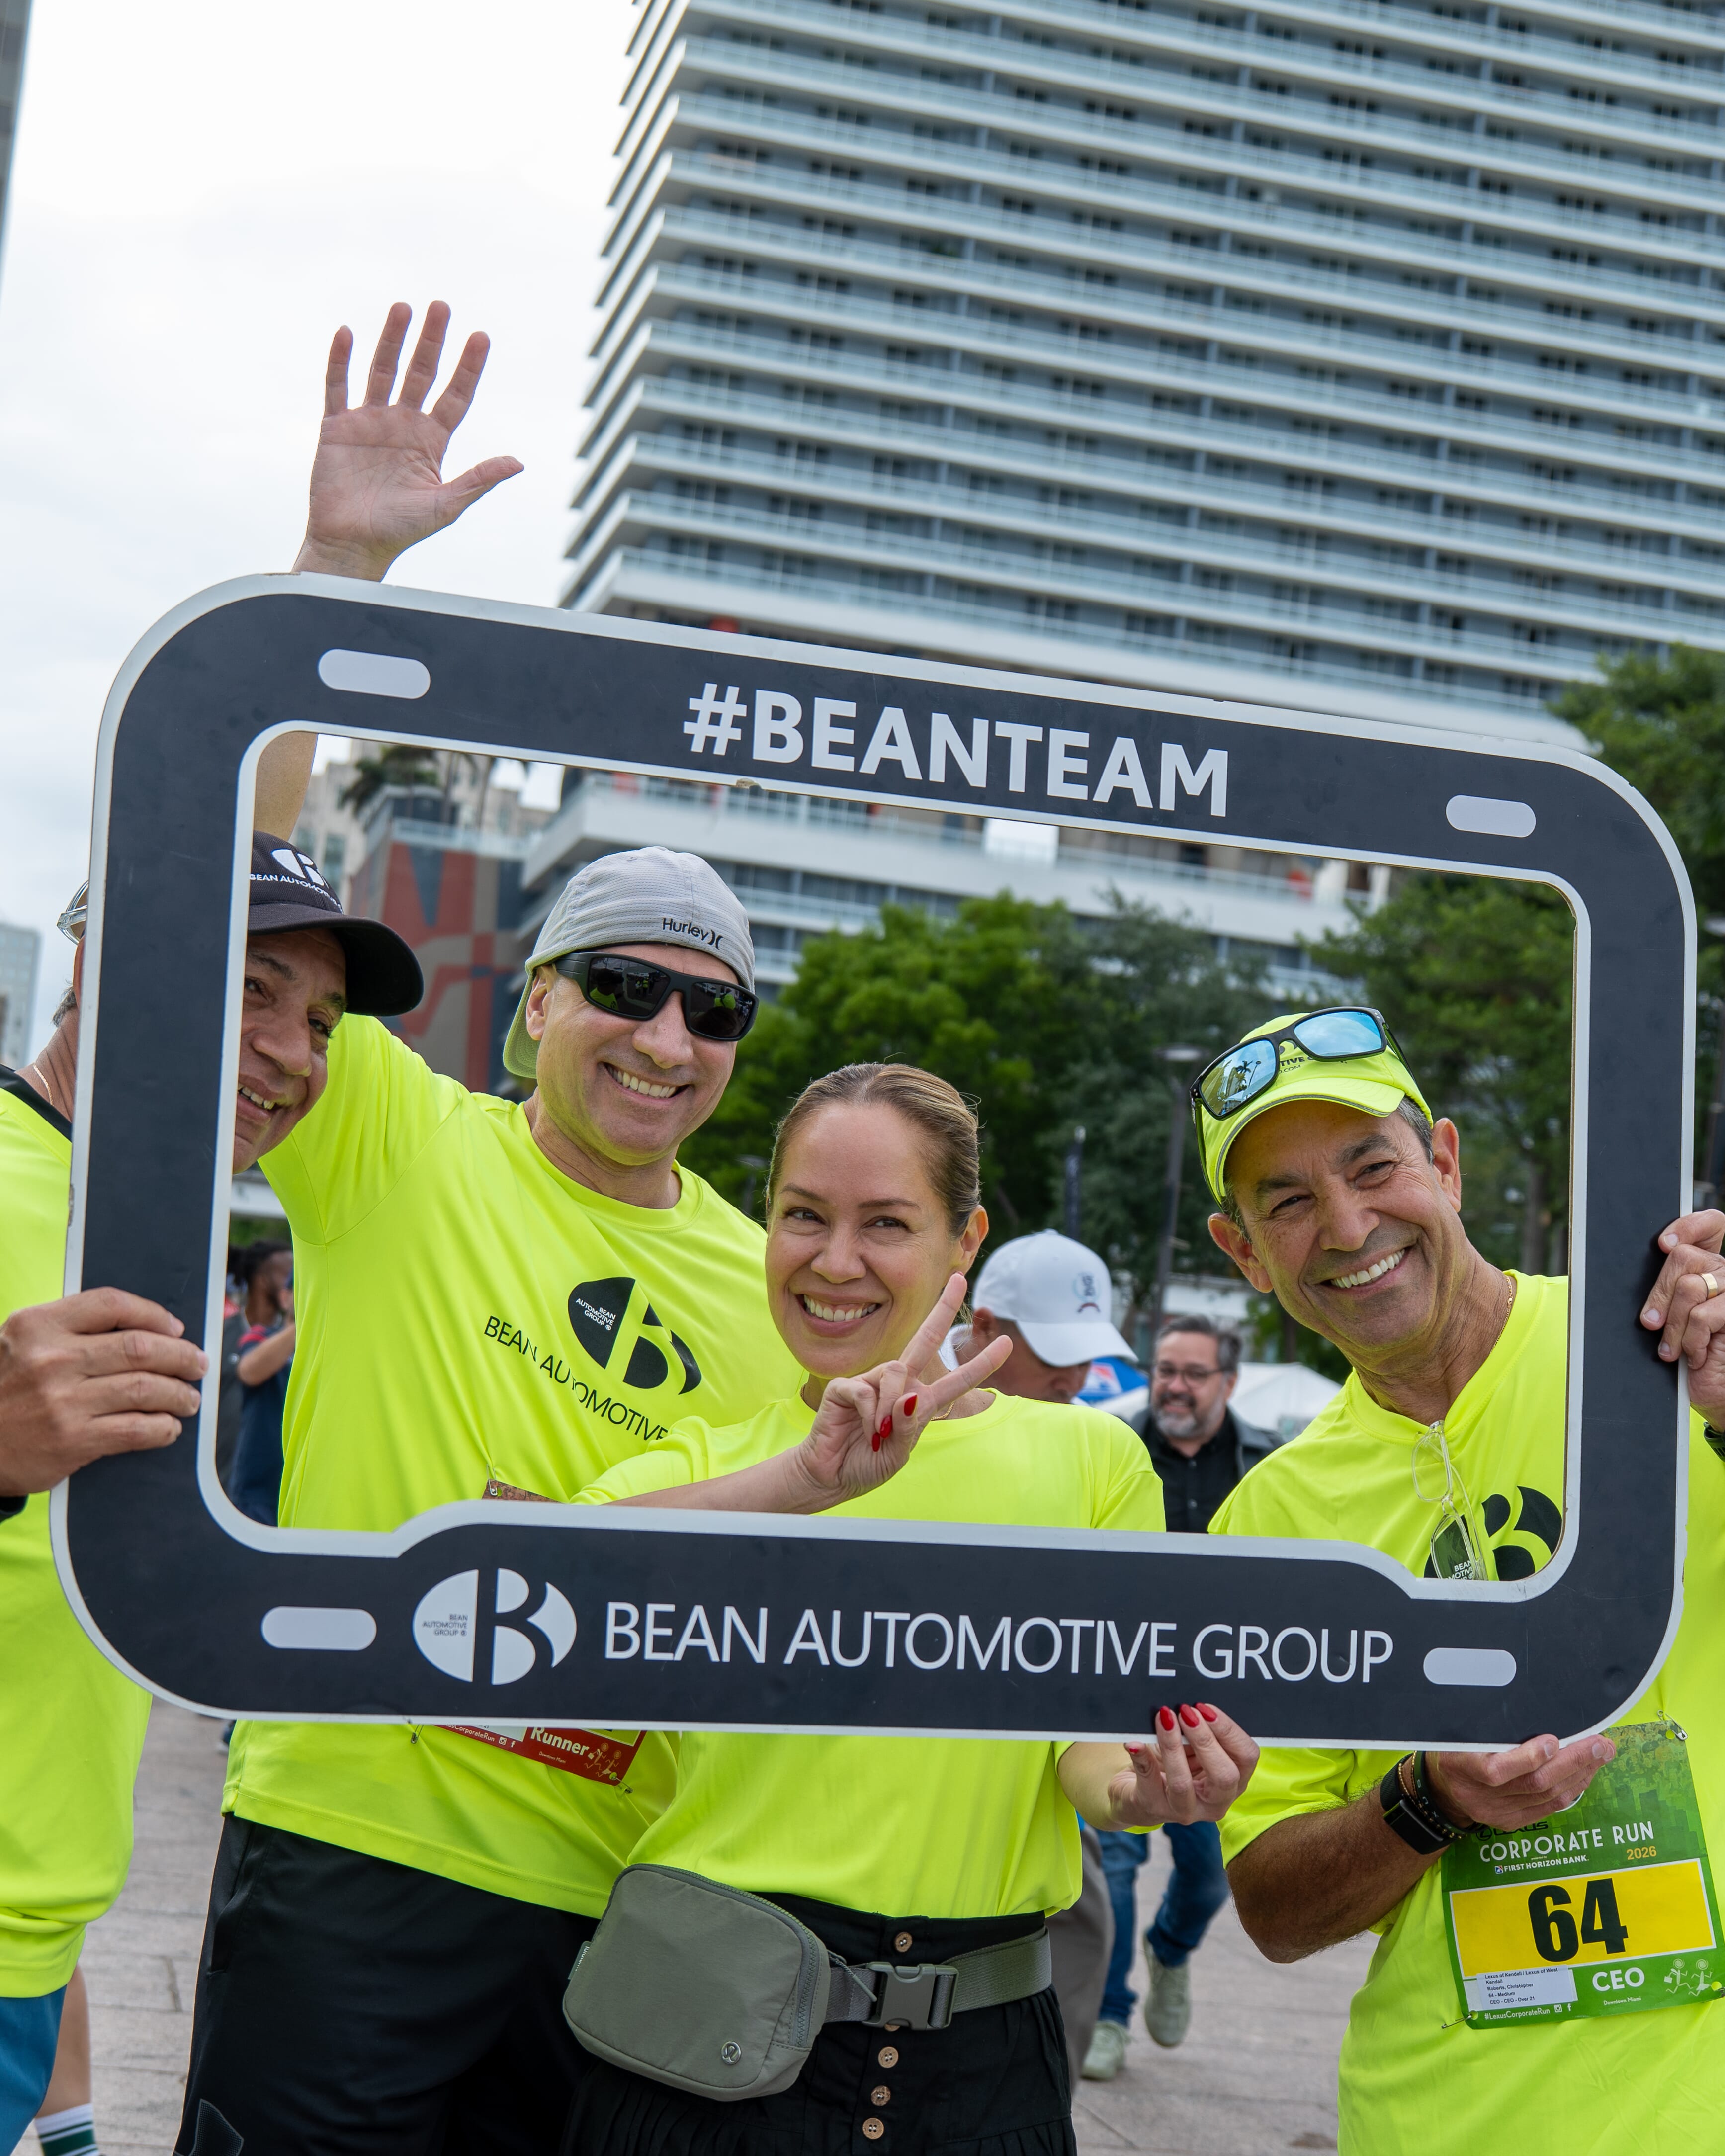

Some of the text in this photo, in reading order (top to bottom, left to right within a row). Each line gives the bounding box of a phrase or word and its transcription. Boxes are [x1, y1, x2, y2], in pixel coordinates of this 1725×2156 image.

[683, 682, 1228, 818] #BEANTEAM
[662, 917, 709, 942] Hurley
[575, 1298, 614, 1326] AUTOMOTIVE
[584, 1310, 605, 1326] GROUP
[599, 1307, 616, 1320] BEAN
[484, 1315, 537, 1362] BEAN
[604, 1601, 1394, 1683] BEAN AUTOMOTIVE GROUP
[530, 1726, 590, 1756] Runner
[1480, 1821, 1654, 1862] CORPORATE RUN
[1627, 1846, 1657, 1861] 2026
[1504, 1863, 1525, 1872] FIRST
[1526, 1859, 1562, 1870] HORIZON
[1527, 1878, 1629, 1962] 64
[1592, 1967, 1645, 1992] CEO
[1484, 2007, 1551, 2020] #LexusCorporateRun
